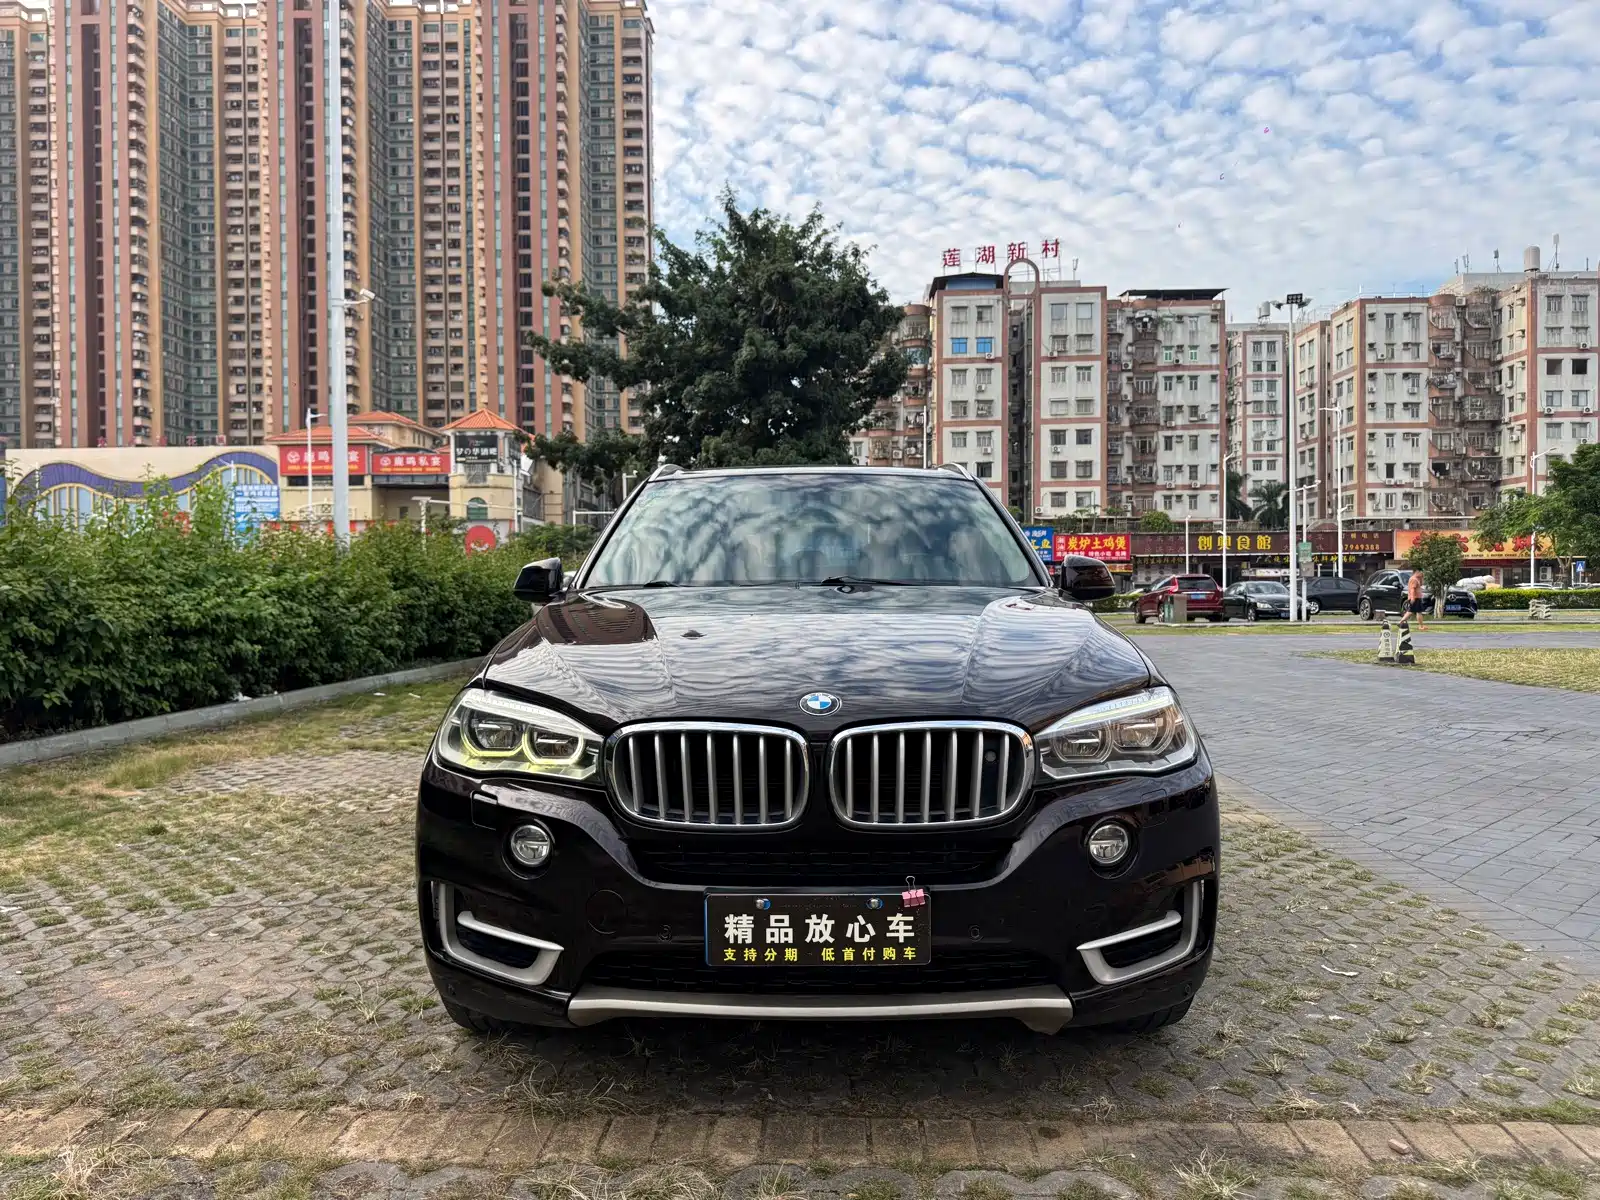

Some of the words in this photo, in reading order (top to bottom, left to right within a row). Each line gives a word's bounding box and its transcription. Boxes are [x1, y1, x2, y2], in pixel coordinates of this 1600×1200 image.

[942, 238, 1060, 267] 莲湖新村
[304, 450, 360, 463] 鹿鸣宴
[1067, 536, 1126, 550] 炭炉土鸡煲
[724, 913, 915, 944] 精品放心车
[723, 948, 798, 962] 支持分期
[821, 947, 917, 961] 低首付购车
